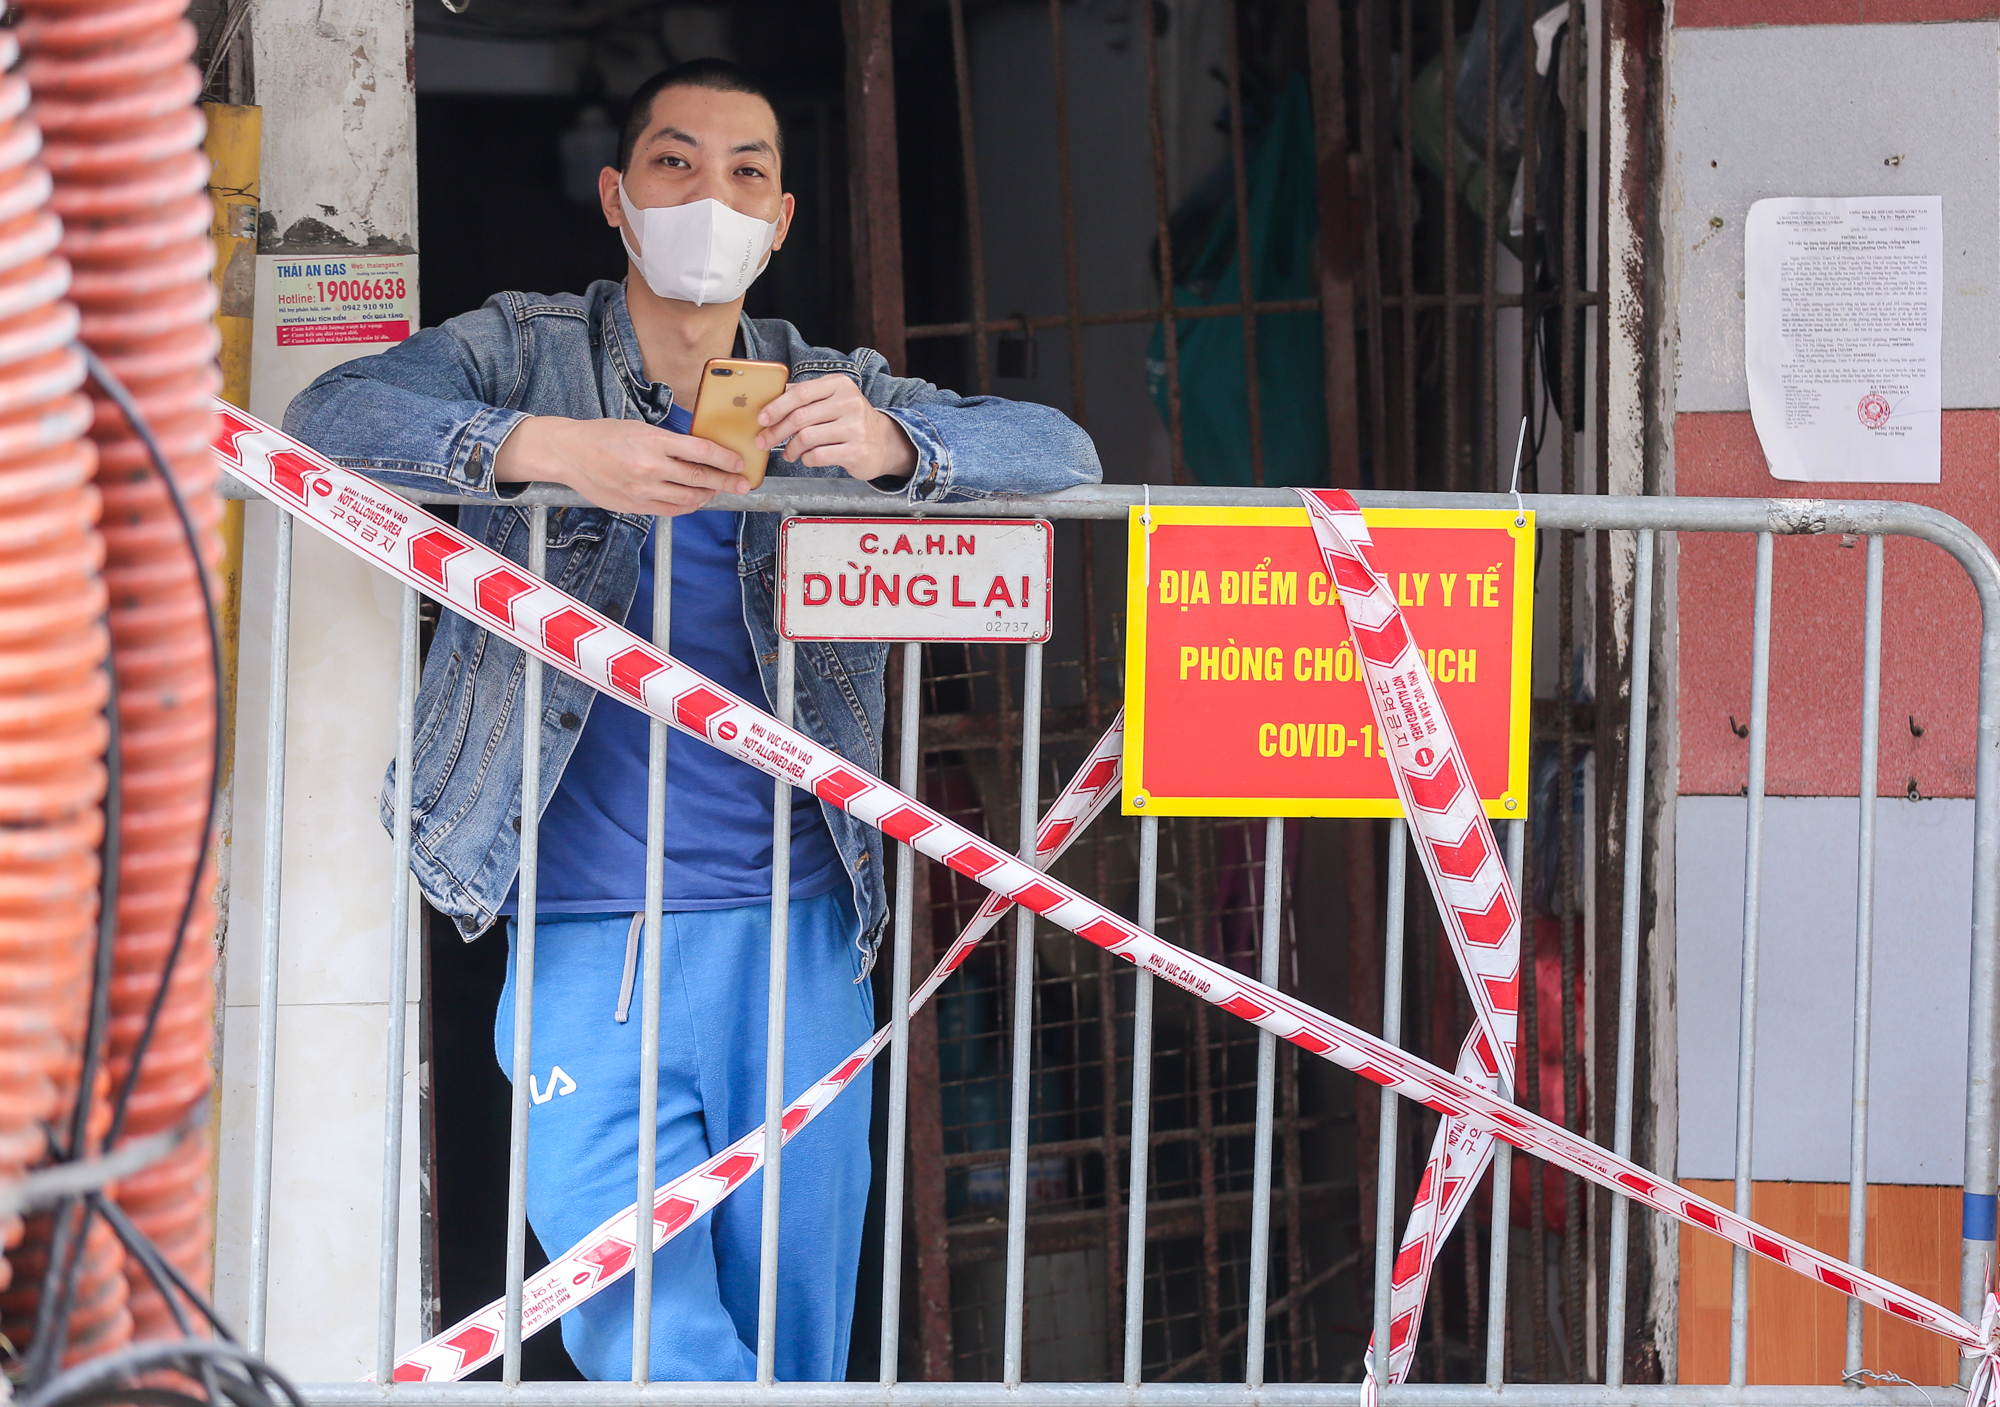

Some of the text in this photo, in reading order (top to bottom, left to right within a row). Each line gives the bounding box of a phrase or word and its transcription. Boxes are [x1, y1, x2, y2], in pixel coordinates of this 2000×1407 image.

[277, 263, 346, 278] THÁI AN GAS
[279, 278, 406, 304] Hotline: 19006638
[379, 302, 394, 310] 910
[344, 485, 359, 498] KHU
[803, 561, 938, 607] DỪNG
[1159, 570, 1210, 613] ĐỊA
[1219, 557, 1297, 606] ĐIỂM
[1398, 572, 1431, 607] LY
[1439, 572, 1458, 607] Y
[1465, 562, 1504, 607] TẾ
[985, 621, 1029, 633] 02737
[1180, 638, 1284, 682] PHÒNG
[1406, 669, 1419, 687] KHU
[1423, 718, 1438, 736] VÀO
[750, 722, 767, 739] KHU
[797, 749, 813, 766] VÀO
[1148, 953, 1166, 969] KHU
[1195, 978, 1212, 994] VÀO
[556, 1292, 572, 1306] KHU
